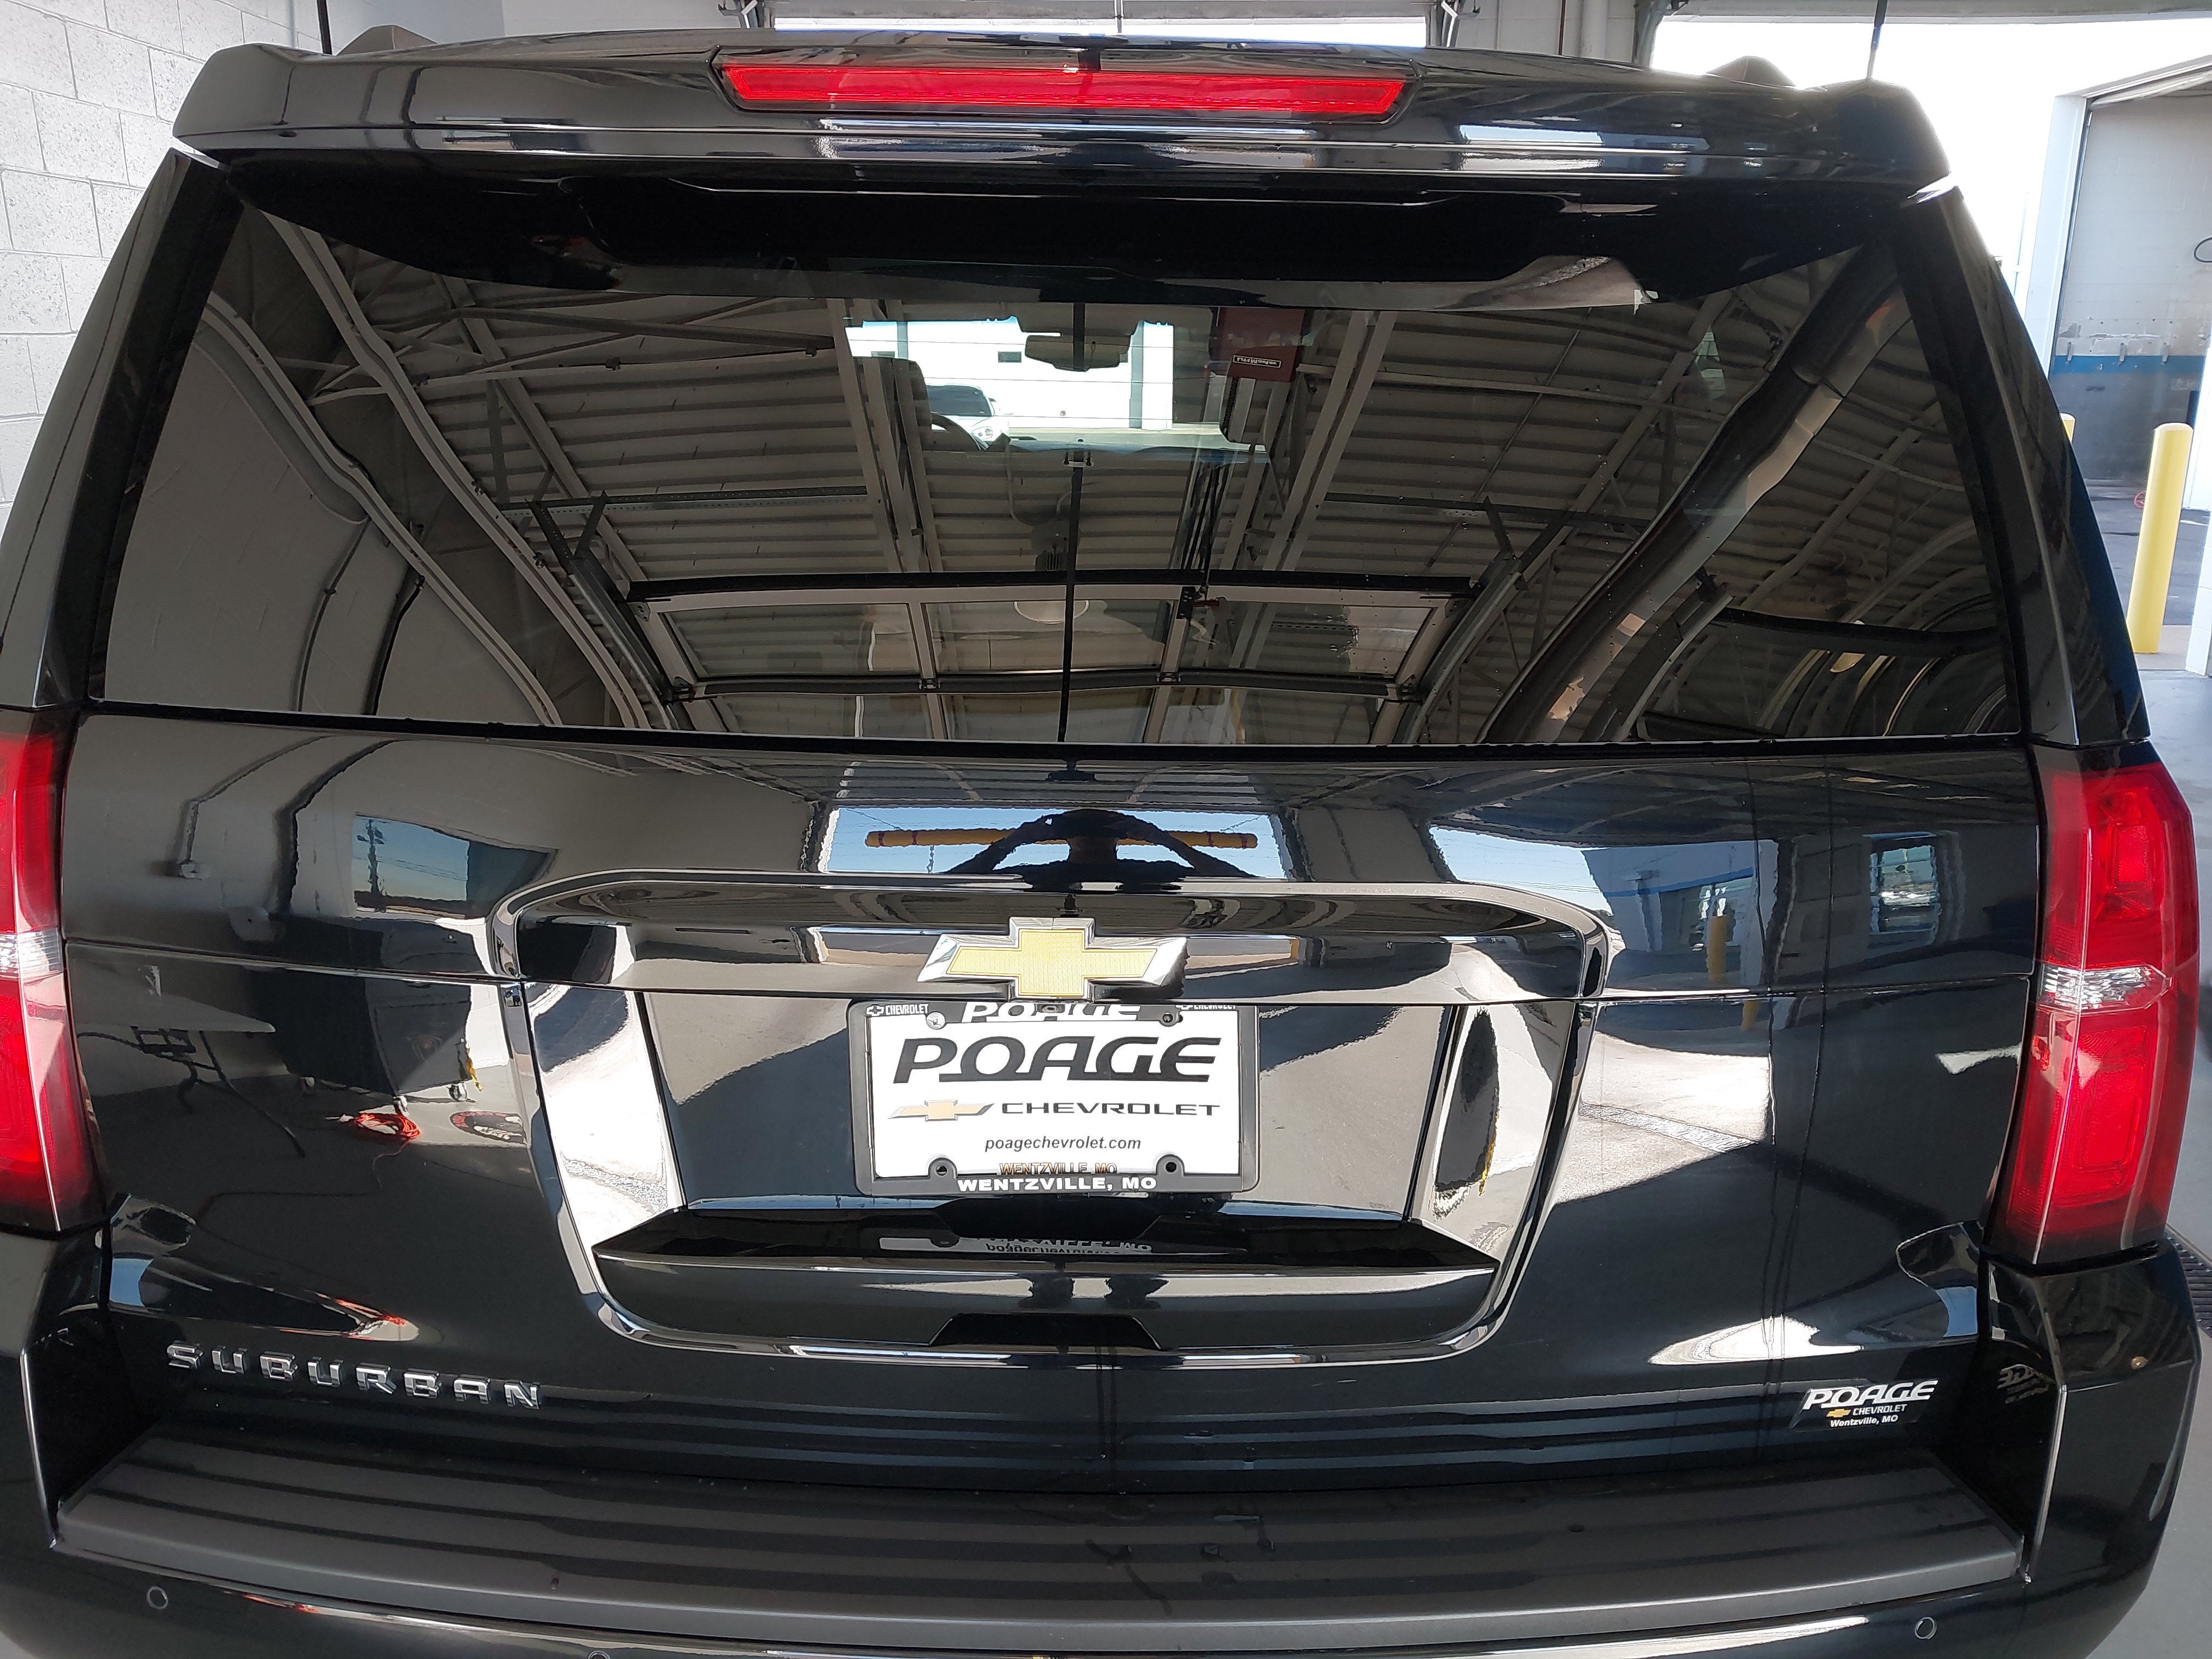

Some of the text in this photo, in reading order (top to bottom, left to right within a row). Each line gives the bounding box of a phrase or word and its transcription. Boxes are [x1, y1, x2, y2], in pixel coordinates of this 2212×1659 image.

[885, 1004, 929, 1015] CHEVROLET
[961, 1002, 1141, 1023] POAGE
[893, 1036, 1222, 1084] POAGE
[1002, 1102, 1220, 1116] CHEVROLET
[985, 1135, 1142, 1152] poagechevrolet.com
[957, 1177, 1157, 1192] WENTZVILLE, MO
[166, 1341, 541, 1410] SUBURBAN
[1802, 1380, 1939, 1410] POAGE
[1852, 1404, 1908, 1416] CHEVROLET
[1830, 1414, 1899, 1428] Wentzville, MO
